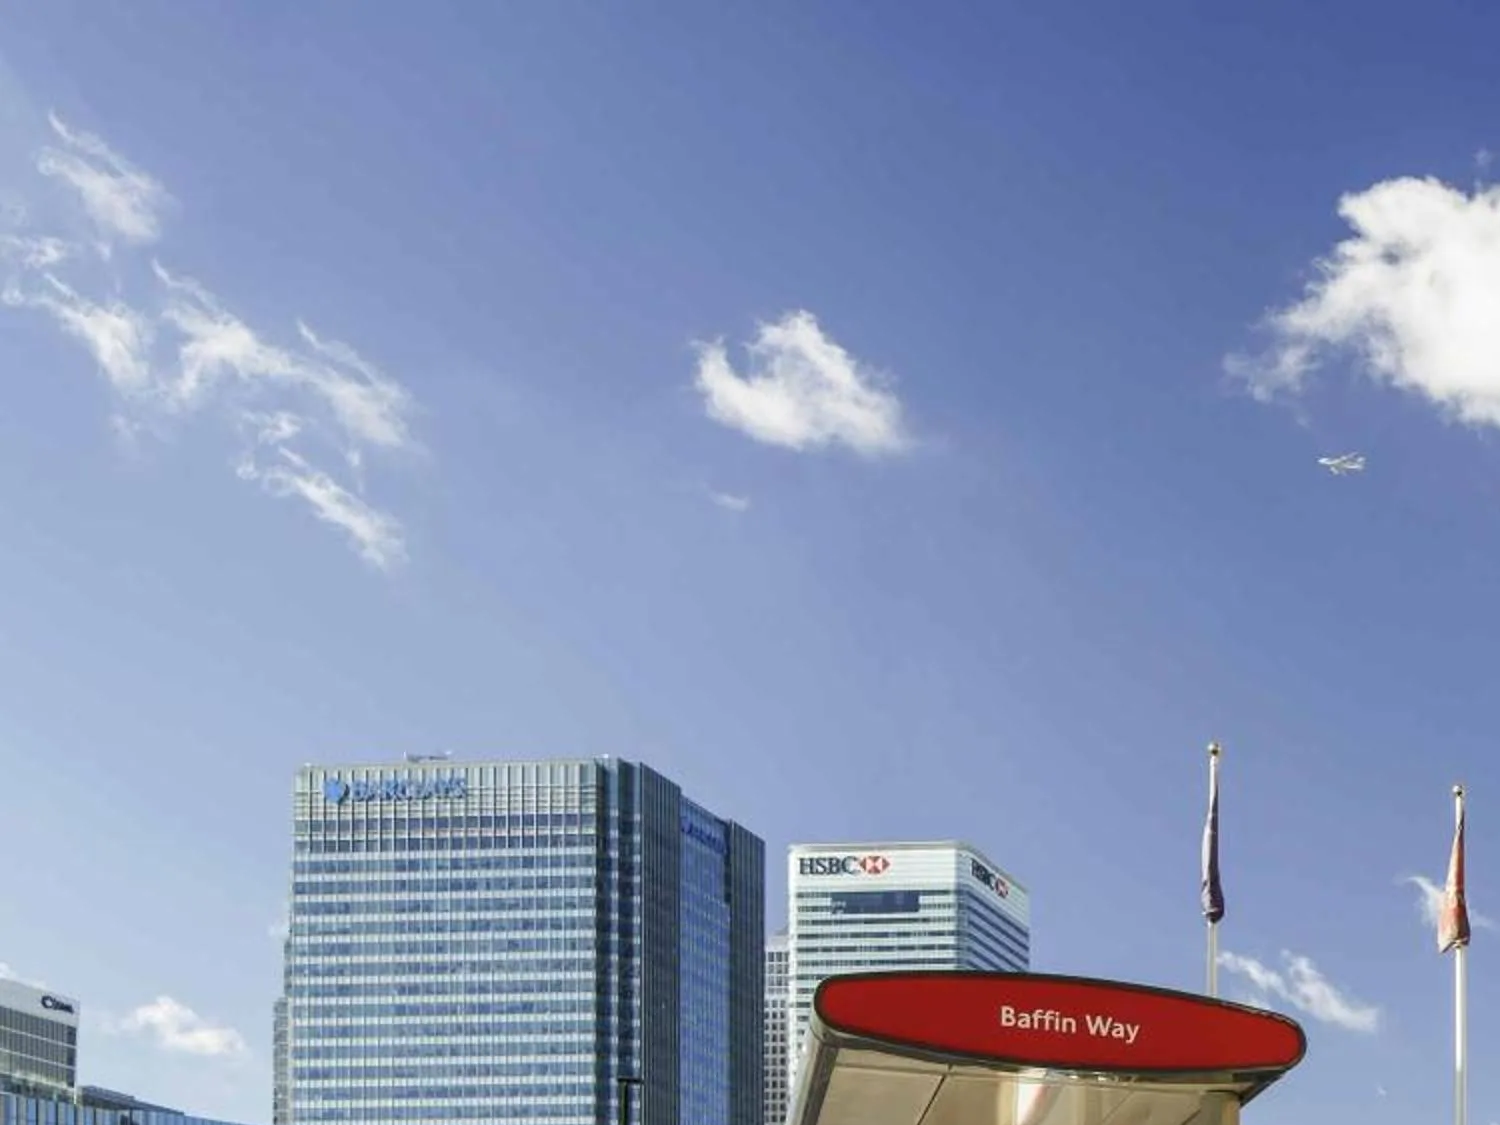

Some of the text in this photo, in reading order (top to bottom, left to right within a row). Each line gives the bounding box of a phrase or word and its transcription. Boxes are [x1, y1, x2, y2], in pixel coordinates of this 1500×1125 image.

[799, 856, 858, 875] HSBC
[1000, 1005, 1140, 1044] Baffin Way
